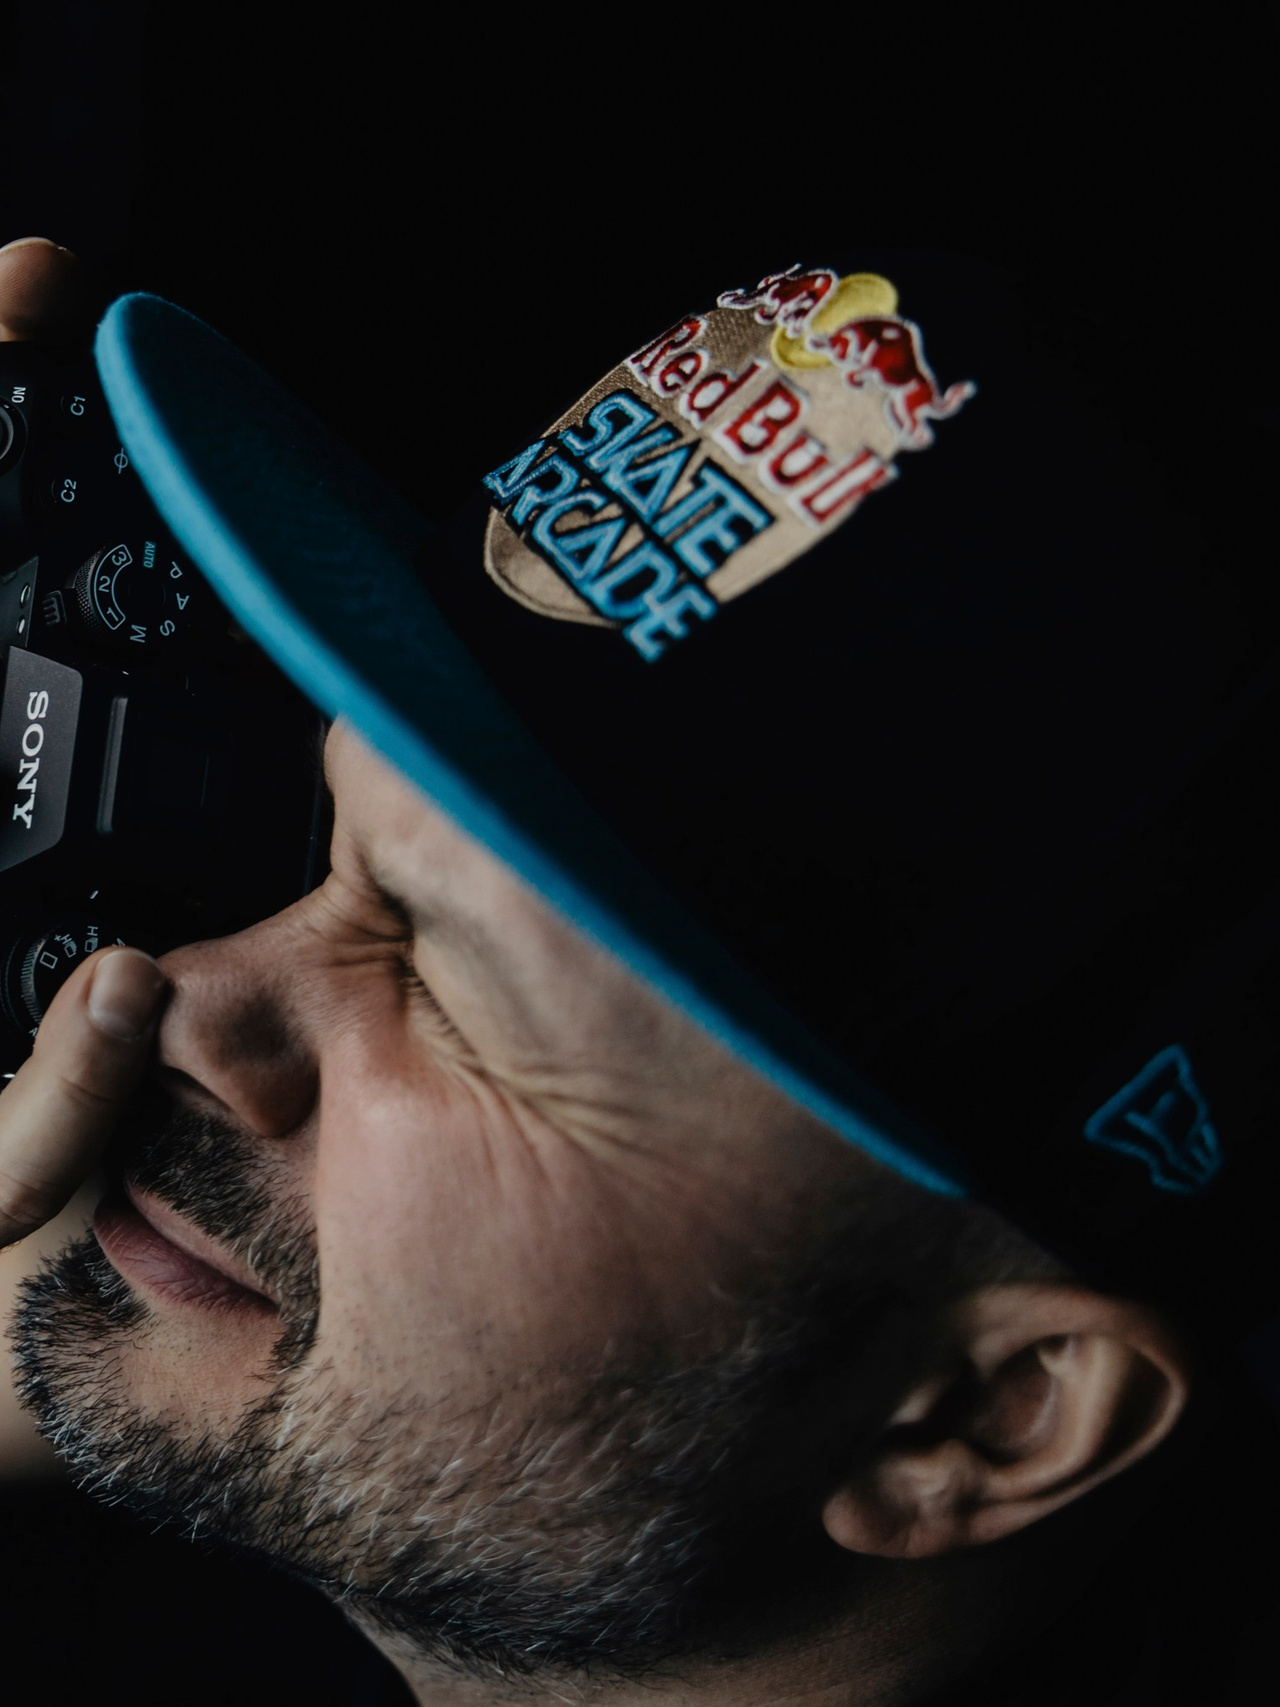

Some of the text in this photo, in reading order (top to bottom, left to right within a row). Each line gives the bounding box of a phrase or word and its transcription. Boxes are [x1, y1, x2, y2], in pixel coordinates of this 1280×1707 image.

[11, 386, 27, 404] ON
[70, 395, 86, 416] C1
[631, 316, 894, 524] Red Bull
[60, 478, 77, 503] C2
[558, 391, 773, 576] SKATE
[111, 550, 128, 567] 3
[143, 541, 157, 569] AUTO
[480, 438, 720, 664] ARCADE
[169, 560, 183, 579] P
[98, 575, 111, 593] 2
[175, 592, 190, 611] A
[106, 606, 120, 622] 1
[129, 624, 147, 644] M
[159, 619, 176, 637] S
[12, 689, 50, 830] SONY
